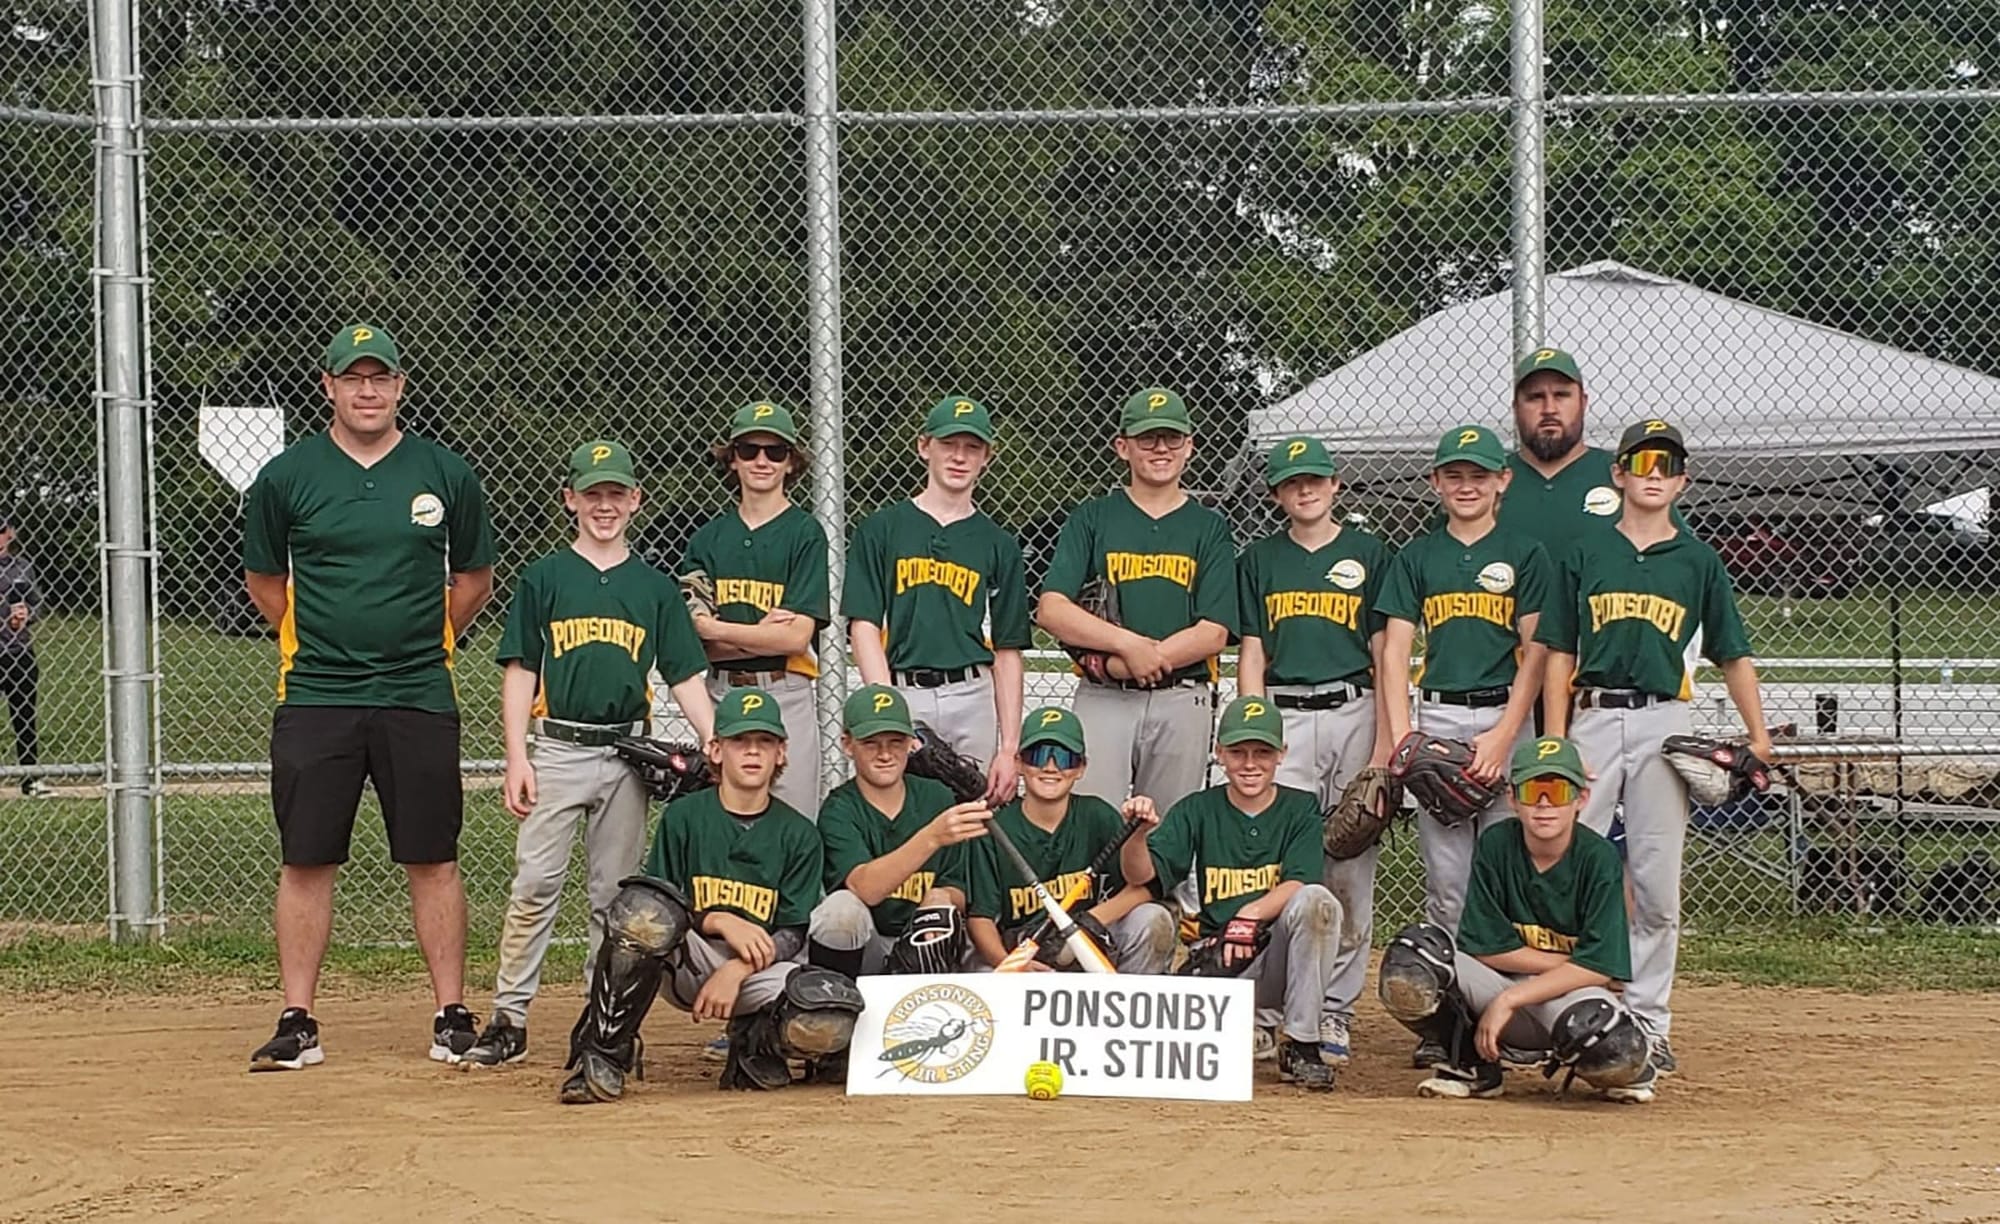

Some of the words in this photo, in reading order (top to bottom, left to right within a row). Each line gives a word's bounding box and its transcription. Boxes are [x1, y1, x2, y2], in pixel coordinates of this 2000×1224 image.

[352, 328, 373, 346] P
[1534, 348, 1556, 366] P
[753, 404, 773, 421] P
[953, 400, 974, 418] P
[1148, 393, 1167, 412] P
[1645, 420, 1667, 435] P
[1458, 430, 1479, 449] P
[592, 445, 612, 466] P
[1288, 441, 1306, 461] P
[897, 556, 981, 607] PONSONBY
[715, 578, 785, 613] NSONBY
[1590, 592, 1687, 641] PONSONBY
[549, 616, 648, 662] PONSONBY
[742, 694, 763, 715] P
[874, 693, 893, 713] P
[1244, 702, 1265, 721] P
[1040, 709, 1062, 727] P
[1537, 740, 1560, 761] P
[692, 876, 779, 926] ONSONB
[894, 986, 986, 1020] PONSONBY
[1024, 989, 1232, 1032] PONSONBY
[945, 1033, 991, 1080] STING
[1103, 1039, 1219, 1081] STING
